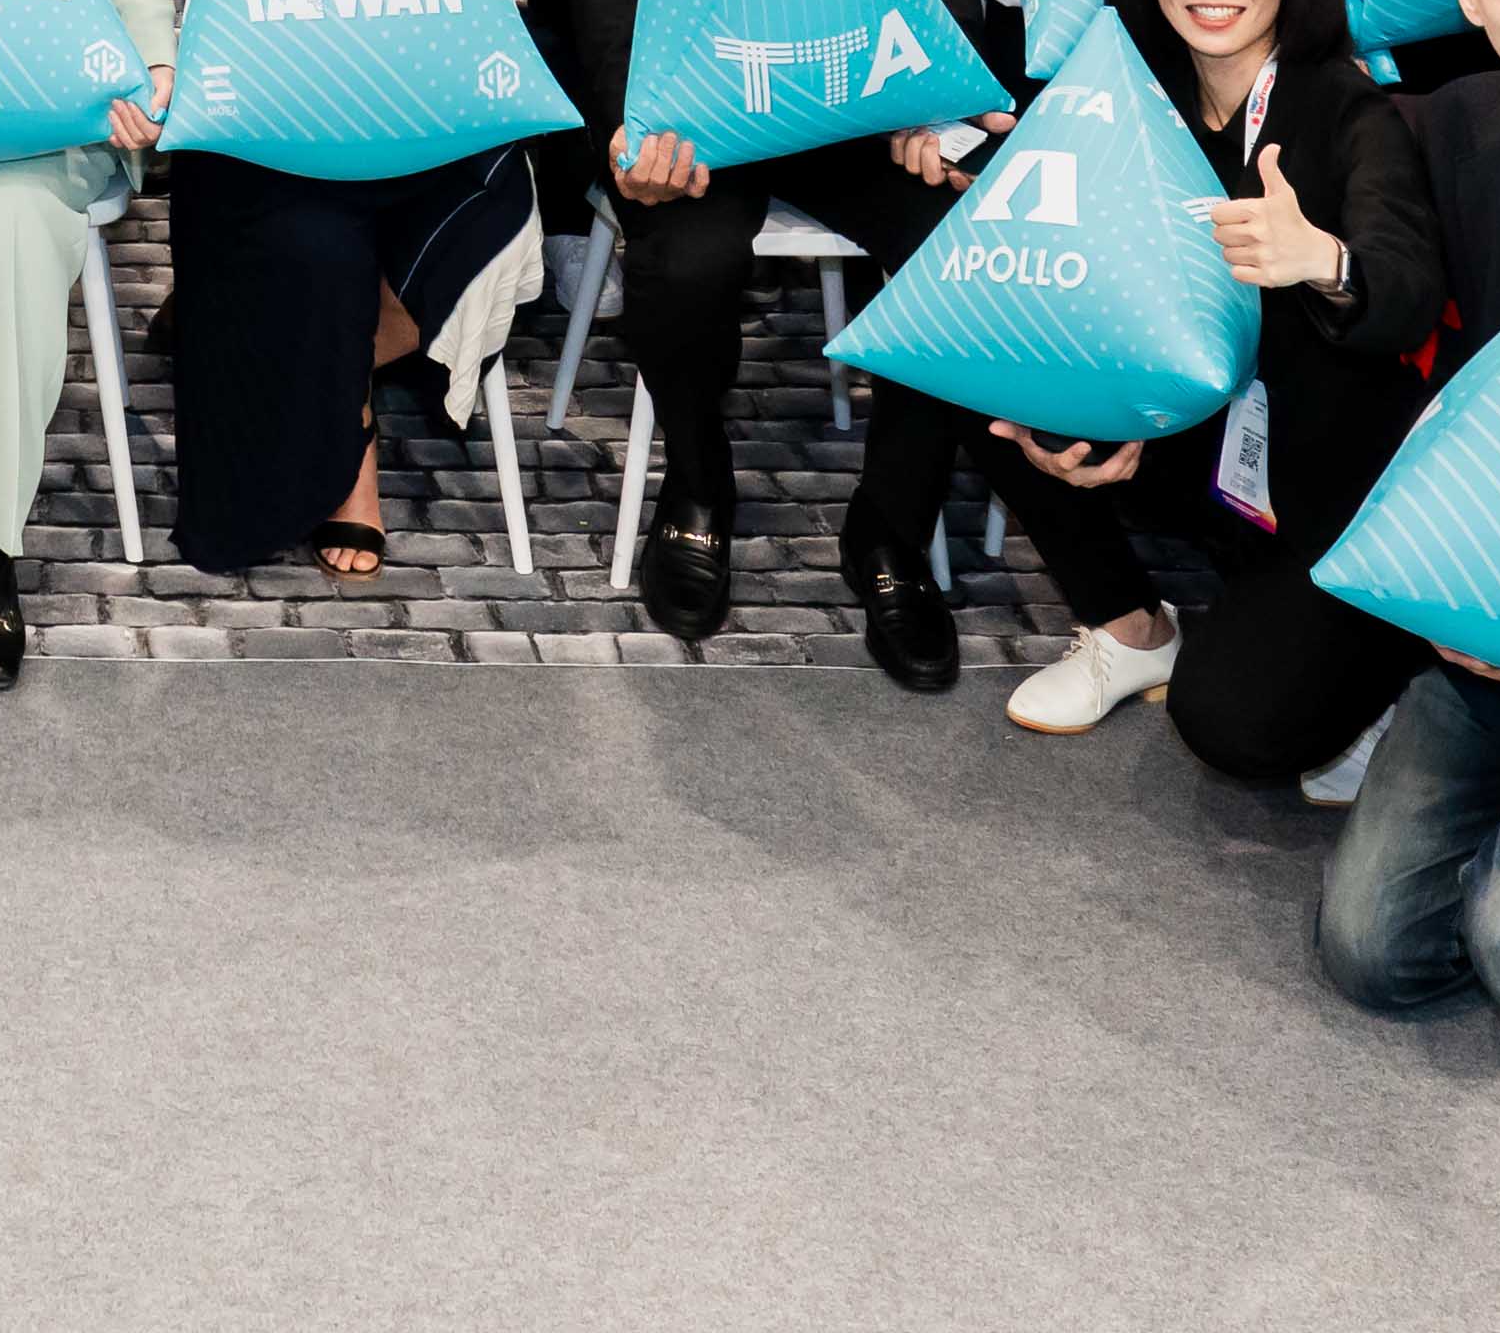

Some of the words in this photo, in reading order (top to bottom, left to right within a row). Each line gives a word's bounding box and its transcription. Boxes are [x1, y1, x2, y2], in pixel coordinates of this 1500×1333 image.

[713, 8, 932, 114] TTA
[1034, 85, 1115, 125] TTA
[940, 243, 1089, 290] APOLLO
